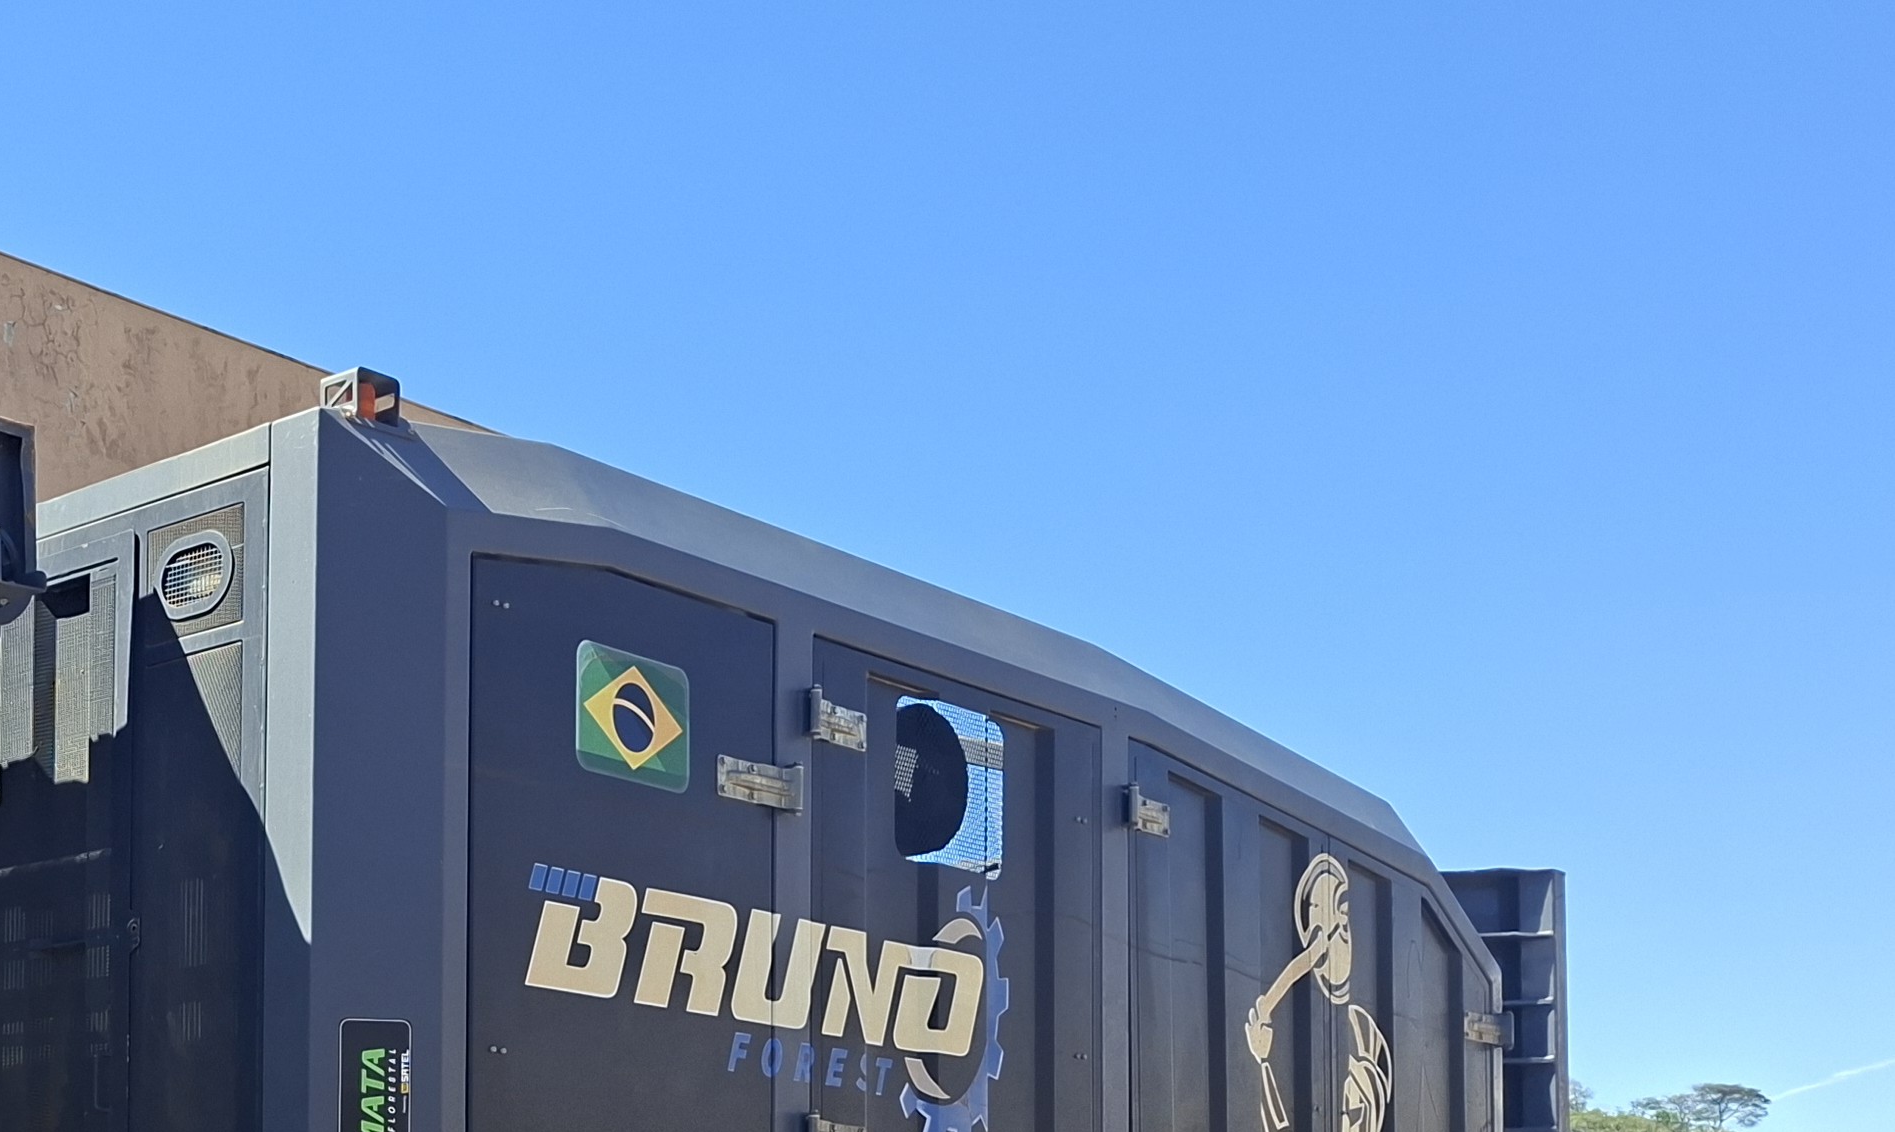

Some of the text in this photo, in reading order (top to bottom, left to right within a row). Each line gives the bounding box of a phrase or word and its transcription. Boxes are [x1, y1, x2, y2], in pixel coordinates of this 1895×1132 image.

[525, 876, 984, 1057] BRUNO
[388, 1049, 397, 1132] FLORESTAL
[727, 1031, 893, 1096] FOREST
